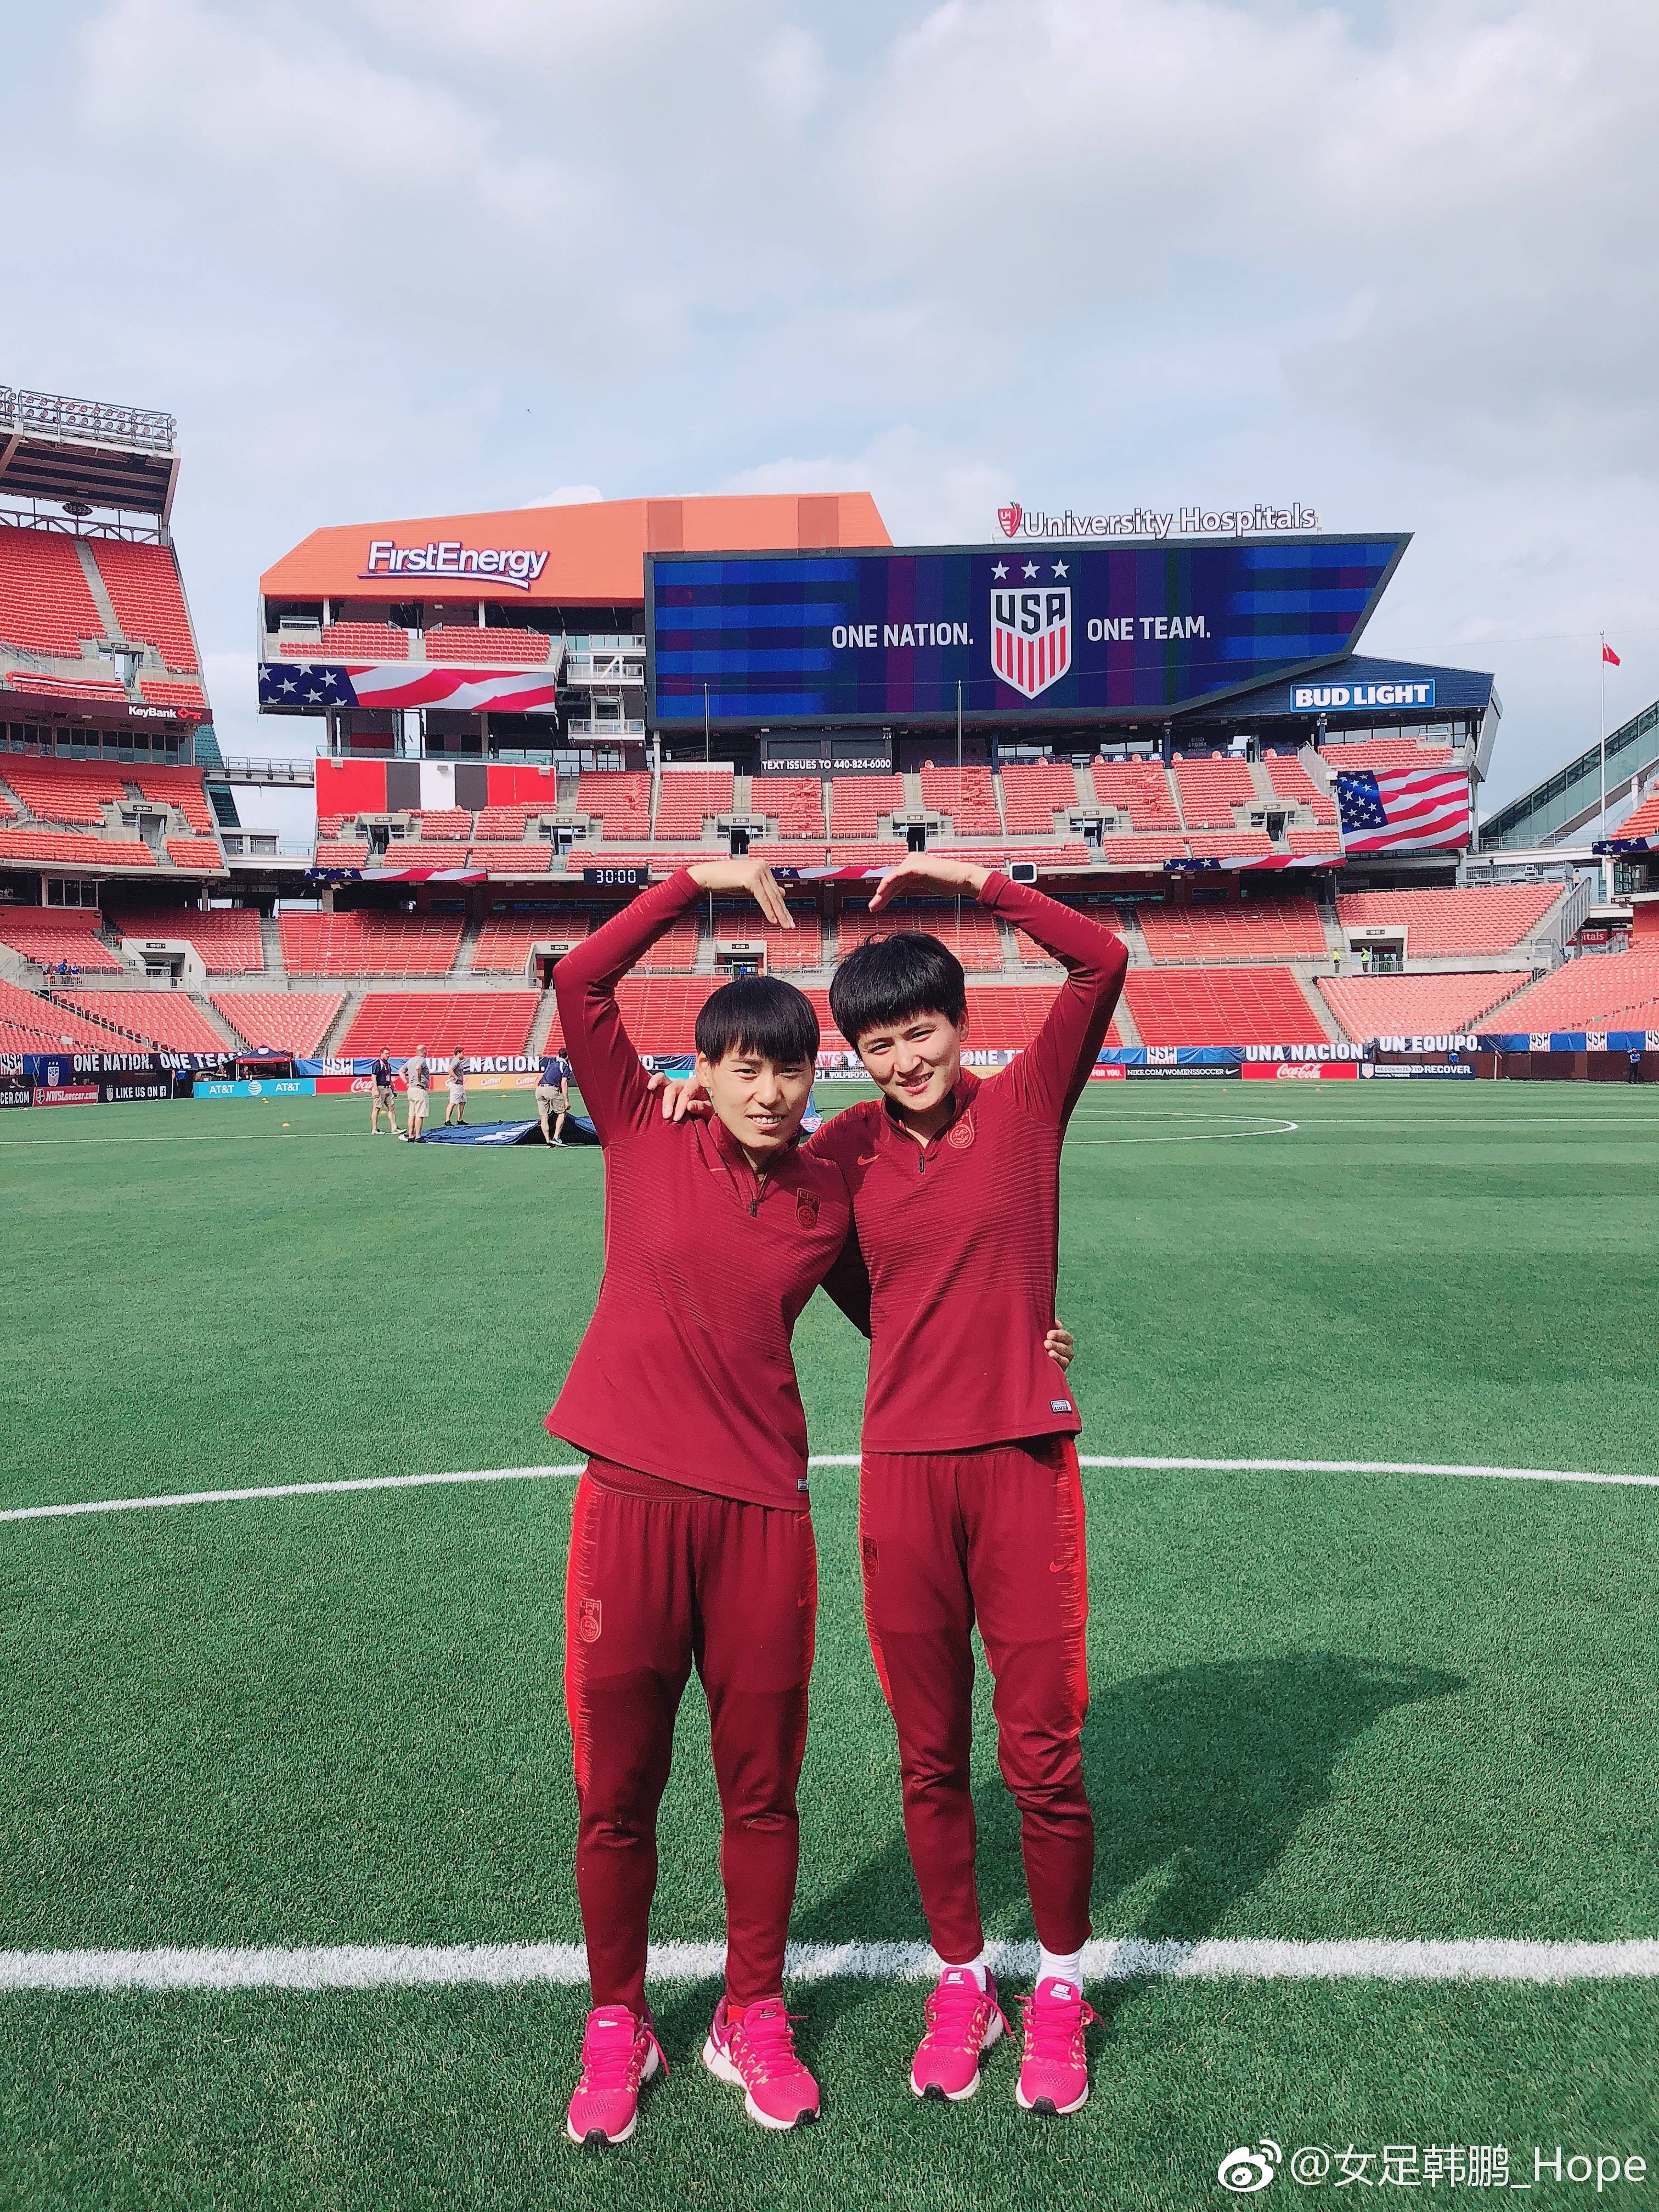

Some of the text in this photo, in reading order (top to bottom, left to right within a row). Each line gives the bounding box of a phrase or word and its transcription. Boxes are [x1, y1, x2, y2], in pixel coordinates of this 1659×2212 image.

[1024, 503, 1316, 540] University Hospitals
[368, 540, 550, 580] FirstEnergy
[996, 594, 1066, 635] USA
[832, 622, 974, 648] ONE NATION.
[1087, 616, 1210, 641] ONE TEAM.
[1295, 684, 1430, 707] BUD LIGHT
[128, 706, 177, 719] KeyBank
[762, 759, 891, 770] TEXT ISSUES TO 440-824-6000
[596, 870, 636, 884] 30:00
[1379, 1034, 1482, 1052] UN EQUIPO.
[1245, 1043, 1369, 1062] UNA NACION.
[74, 1054, 100, 1072] ONE
[104, 1053, 153, 1071] NATION.
[160, 1052, 191, 1069] ONE
[425, 1056, 545, 1073] UN NACION.
[1424, 1065, 1472, 1074] RECOVER.
[1276, 1063, 1323, 1079] Coca-Cola
[116, 1087, 133, 1098] LIKE
[135, 1086, 145, 1098] US
[148, 1086, 158, 1097] ON
[209, 1084, 235, 1094] AT&T
[275, 1082, 300, 1092] AT&T
